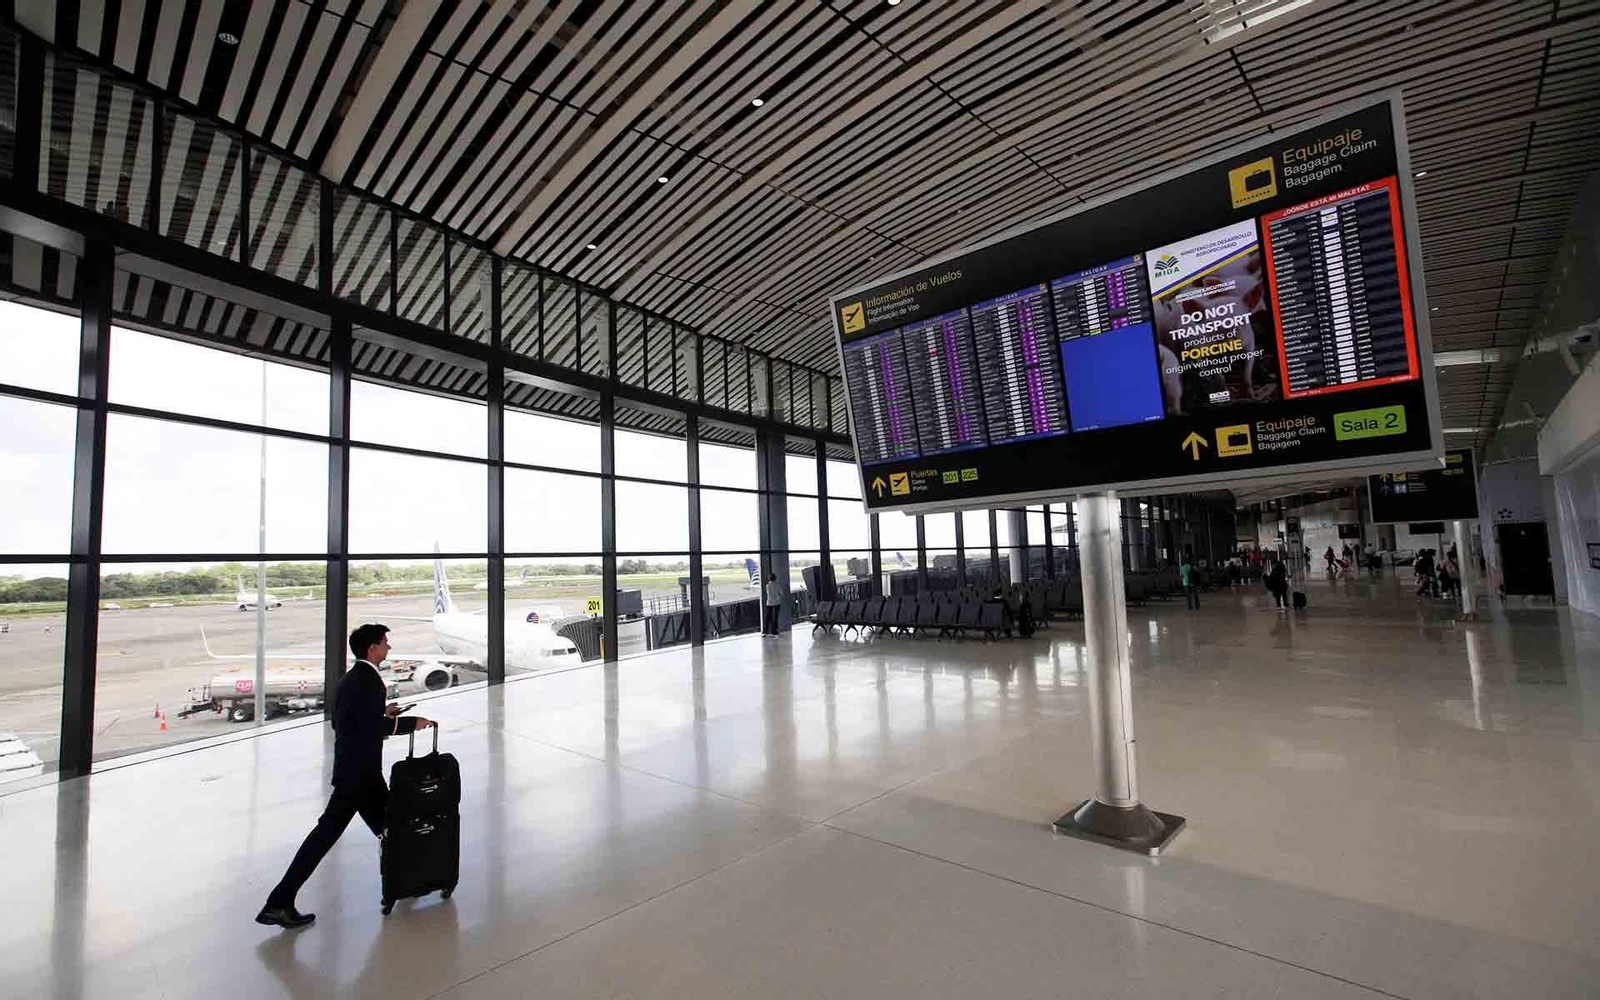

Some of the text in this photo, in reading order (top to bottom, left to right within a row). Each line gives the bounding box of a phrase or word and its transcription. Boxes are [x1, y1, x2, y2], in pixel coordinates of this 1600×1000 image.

[1282, 128, 1362, 164] Equipaje
[1283, 139, 1377, 177] Baggage Claim
[1285, 164, 1342, 188] Bagagem
[1338, 184, 1370, 199] MALETA?
[1154, 266, 1179, 278] MIDA
[866, 269, 962, 308] Información de Vuelos
[867, 297, 914, 317] Flight Information
[1180, 302, 1236, 325] DO NOT
[1169, 313, 1252, 340] TRANSPORT
[1184, 328, 1238, 349] products of
[1181, 339, 1243, 361] PORCINE
[1166, 349, 1264, 375] origin without proper
[1199, 364, 1232, 377] control
[1256, 413, 1398, 433] Equipaje Sala 2
[1257, 427, 1326, 442] Baggage Claim
[1258, 439, 1301, 450] Bagagem
[911, 469, 977, 481] Puertas 201 225
[588, 600, 600, 610] 201
